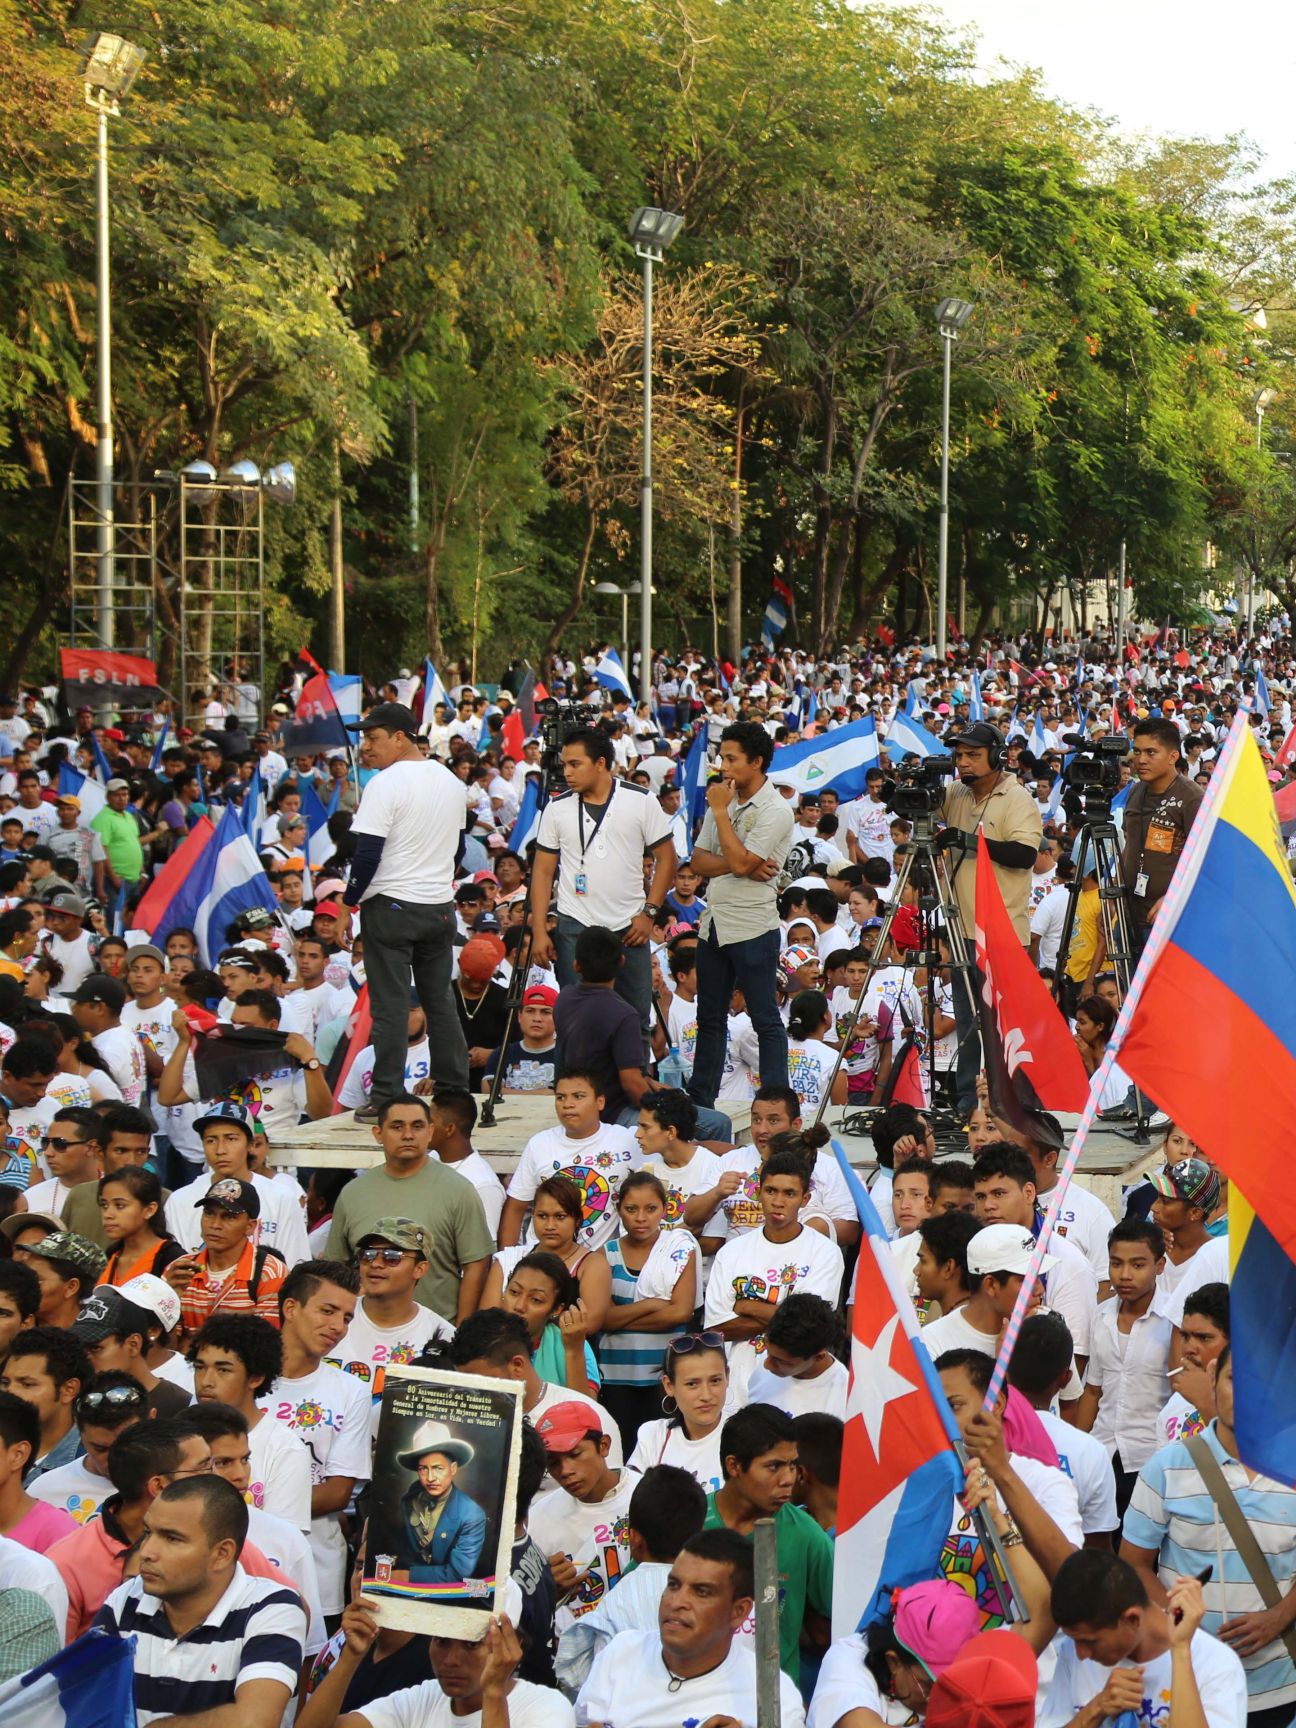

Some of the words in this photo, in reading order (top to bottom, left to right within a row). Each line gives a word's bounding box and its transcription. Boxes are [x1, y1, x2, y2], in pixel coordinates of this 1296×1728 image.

[79, 668, 140, 686] FSLN
[407, 1385, 416, 1394] 80
[418, 1389, 452, 1399] Aniversario
[454, 1393, 464, 1401] del
[393, 1399, 414, 1409] General
[416, 1402, 424, 1410] de
[426, 1404, 448, 1413] Hombres
[456, 1408, 478, 1418] Mujeres
[468, 1403, 492, 1412] nuestro
[392, 1407, 414, 1417] Siempre
[476, 1418, 496, 1427] Verdad
